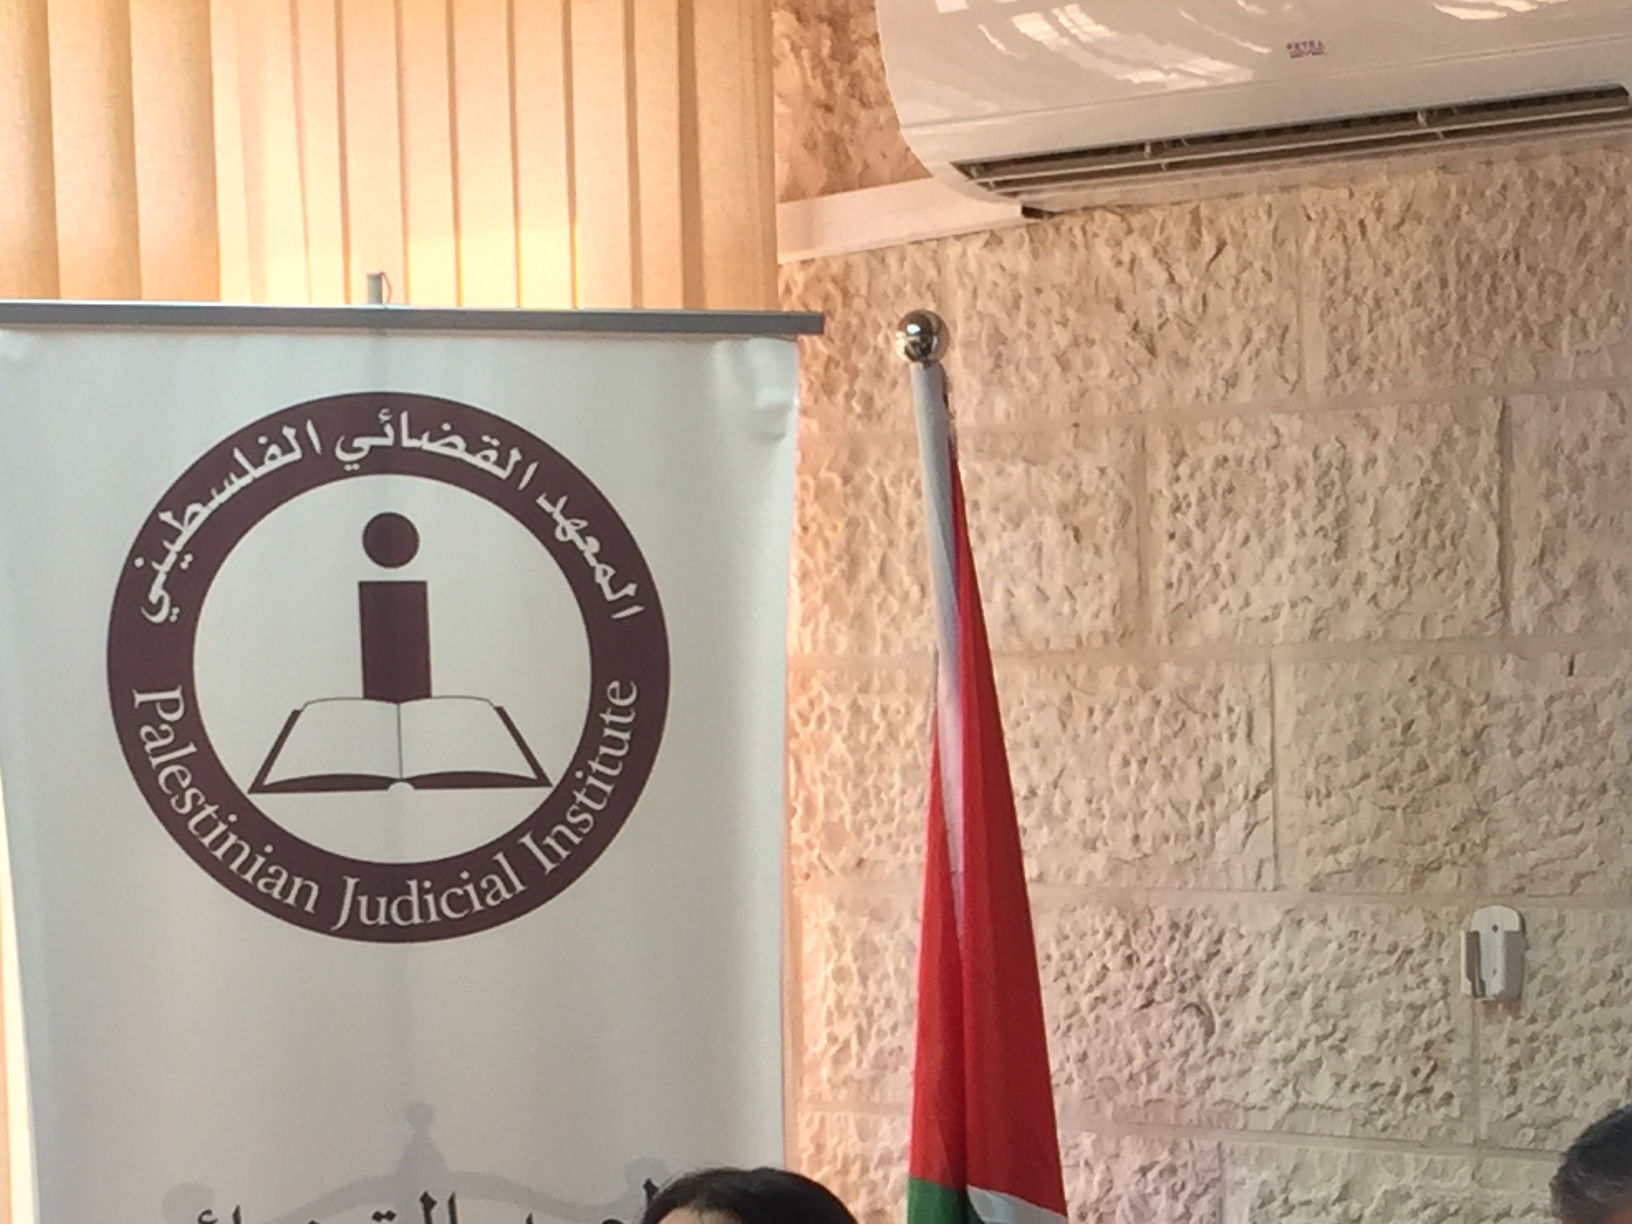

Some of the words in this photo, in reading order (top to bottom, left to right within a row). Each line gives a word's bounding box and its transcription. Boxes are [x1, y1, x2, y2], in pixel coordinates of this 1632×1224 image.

[139, 418, 322, 625] الفلسطيني
[334, 407, 538, 492] القضائي
[536, 490, 645, 621] المعهد
[132, 684, 320, 914] Palestinian
[331, 851, 526, 932] Judicial
[517, 679, 639, 877] Institute
